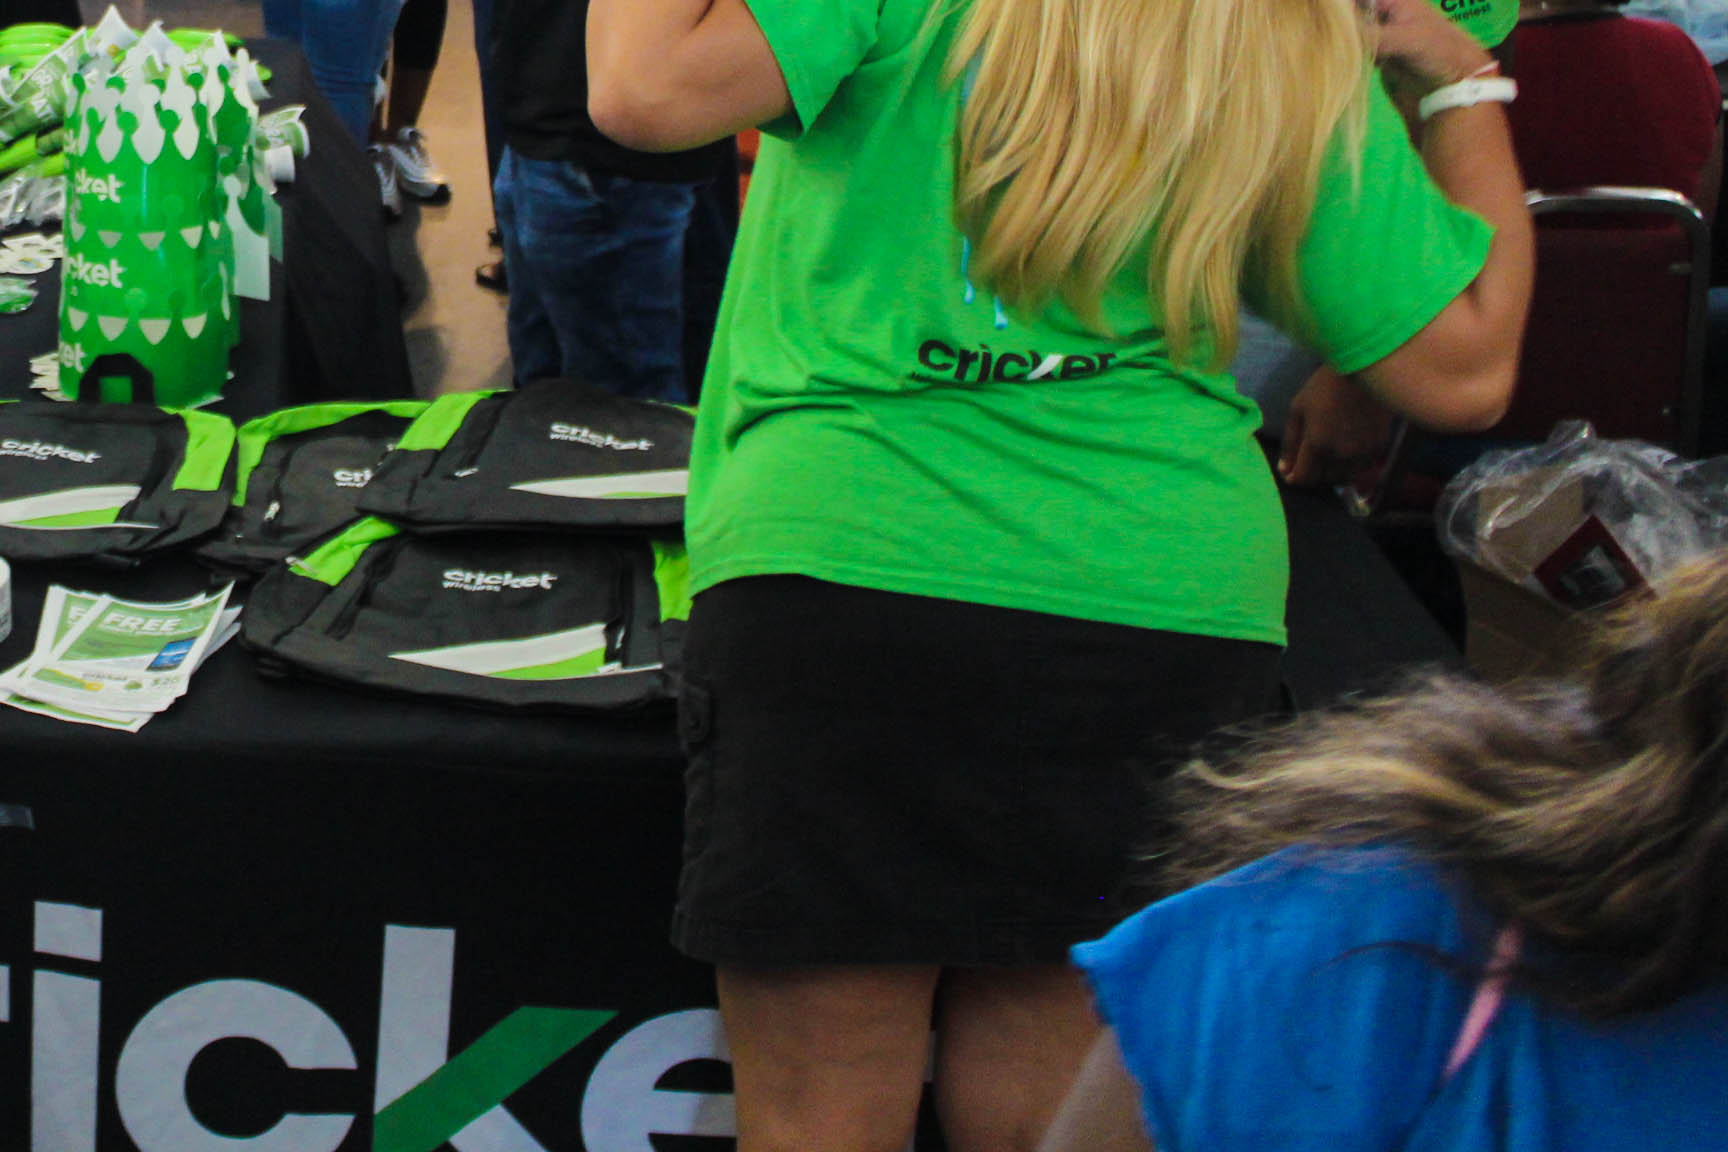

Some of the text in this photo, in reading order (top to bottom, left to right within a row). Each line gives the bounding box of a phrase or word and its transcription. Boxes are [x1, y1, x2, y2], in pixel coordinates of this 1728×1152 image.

[550, 422, 655, 451] cricket
[443, 569, 558, 591] cricket
[104, 611, 184, 633] FREE
